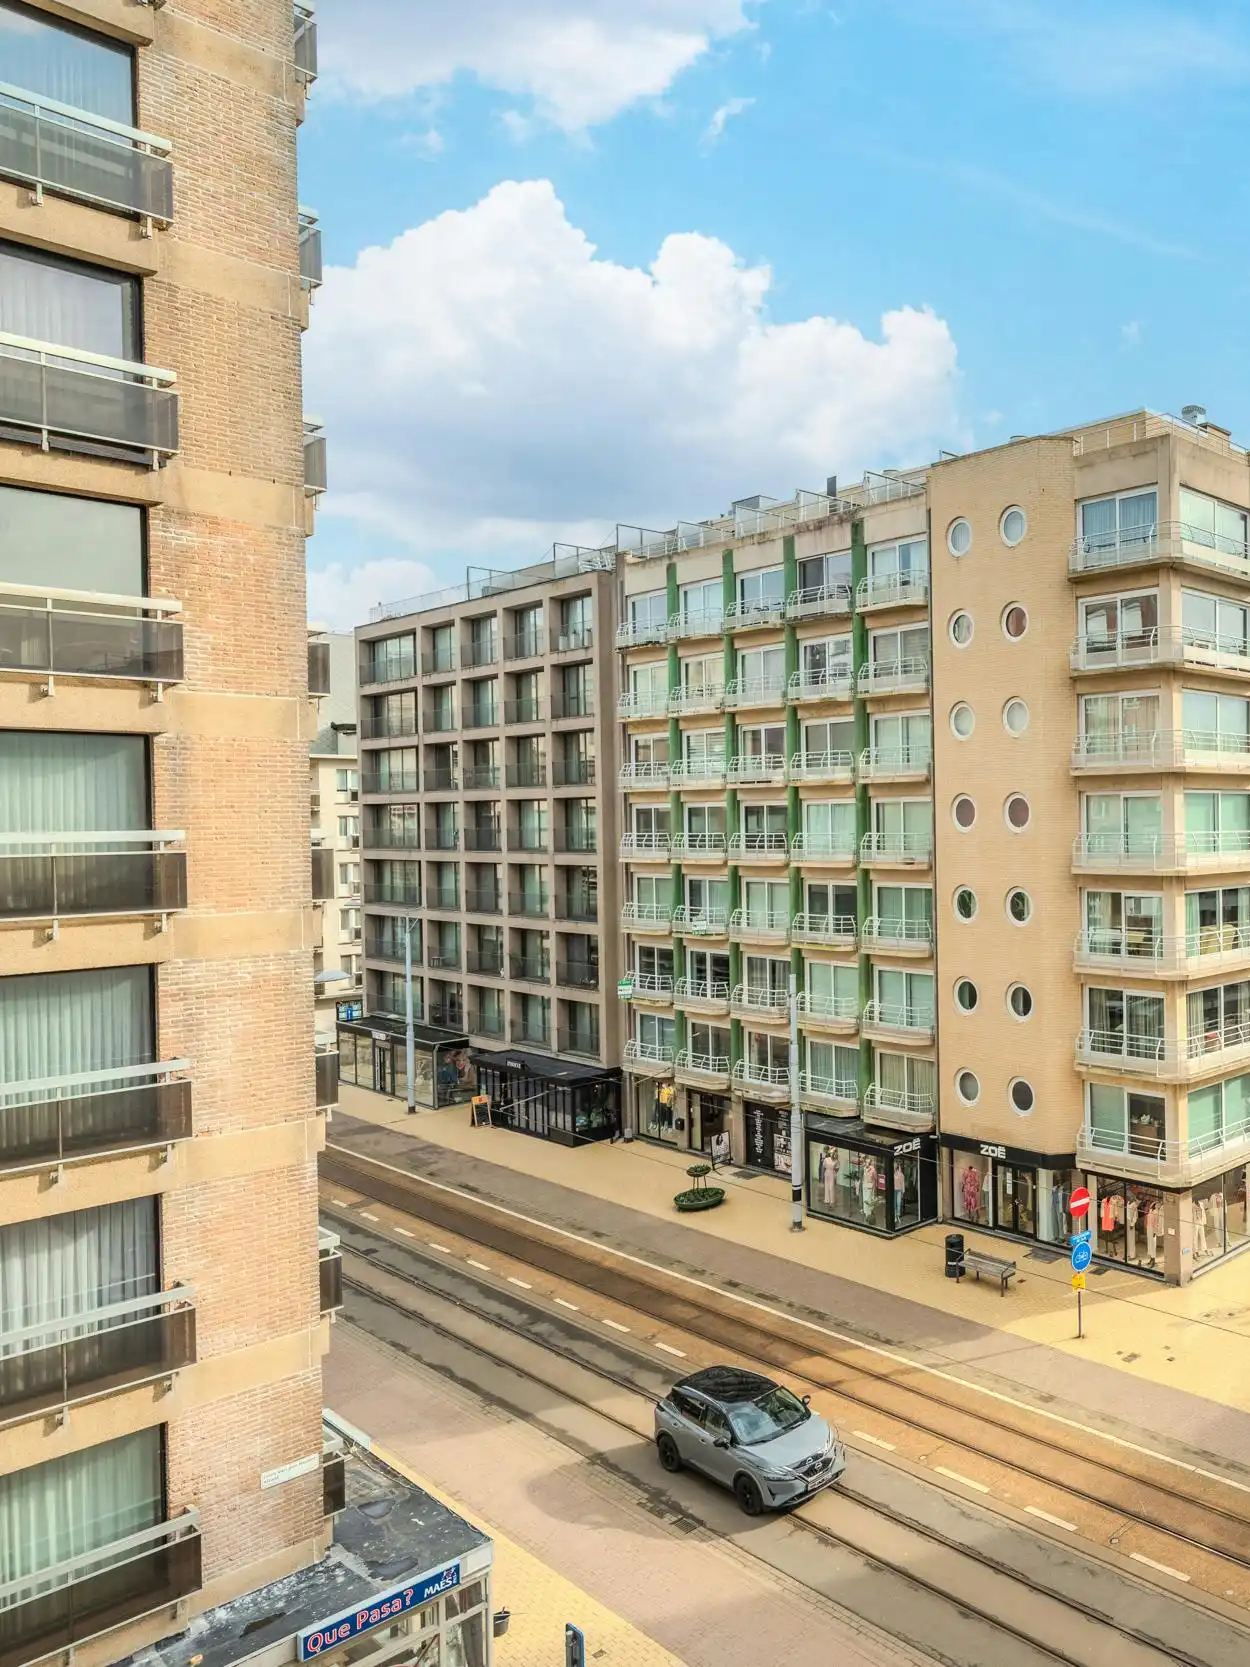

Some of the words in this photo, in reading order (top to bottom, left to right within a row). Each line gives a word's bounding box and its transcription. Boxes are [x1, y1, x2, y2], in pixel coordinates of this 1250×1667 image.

[893, 1137, 921, 1157] ZOË
[980, 1143, 1006, 1160] ZOË
[424, 1577, 452, 1598] MAES
[307, 1623, 350, 1654] Que
